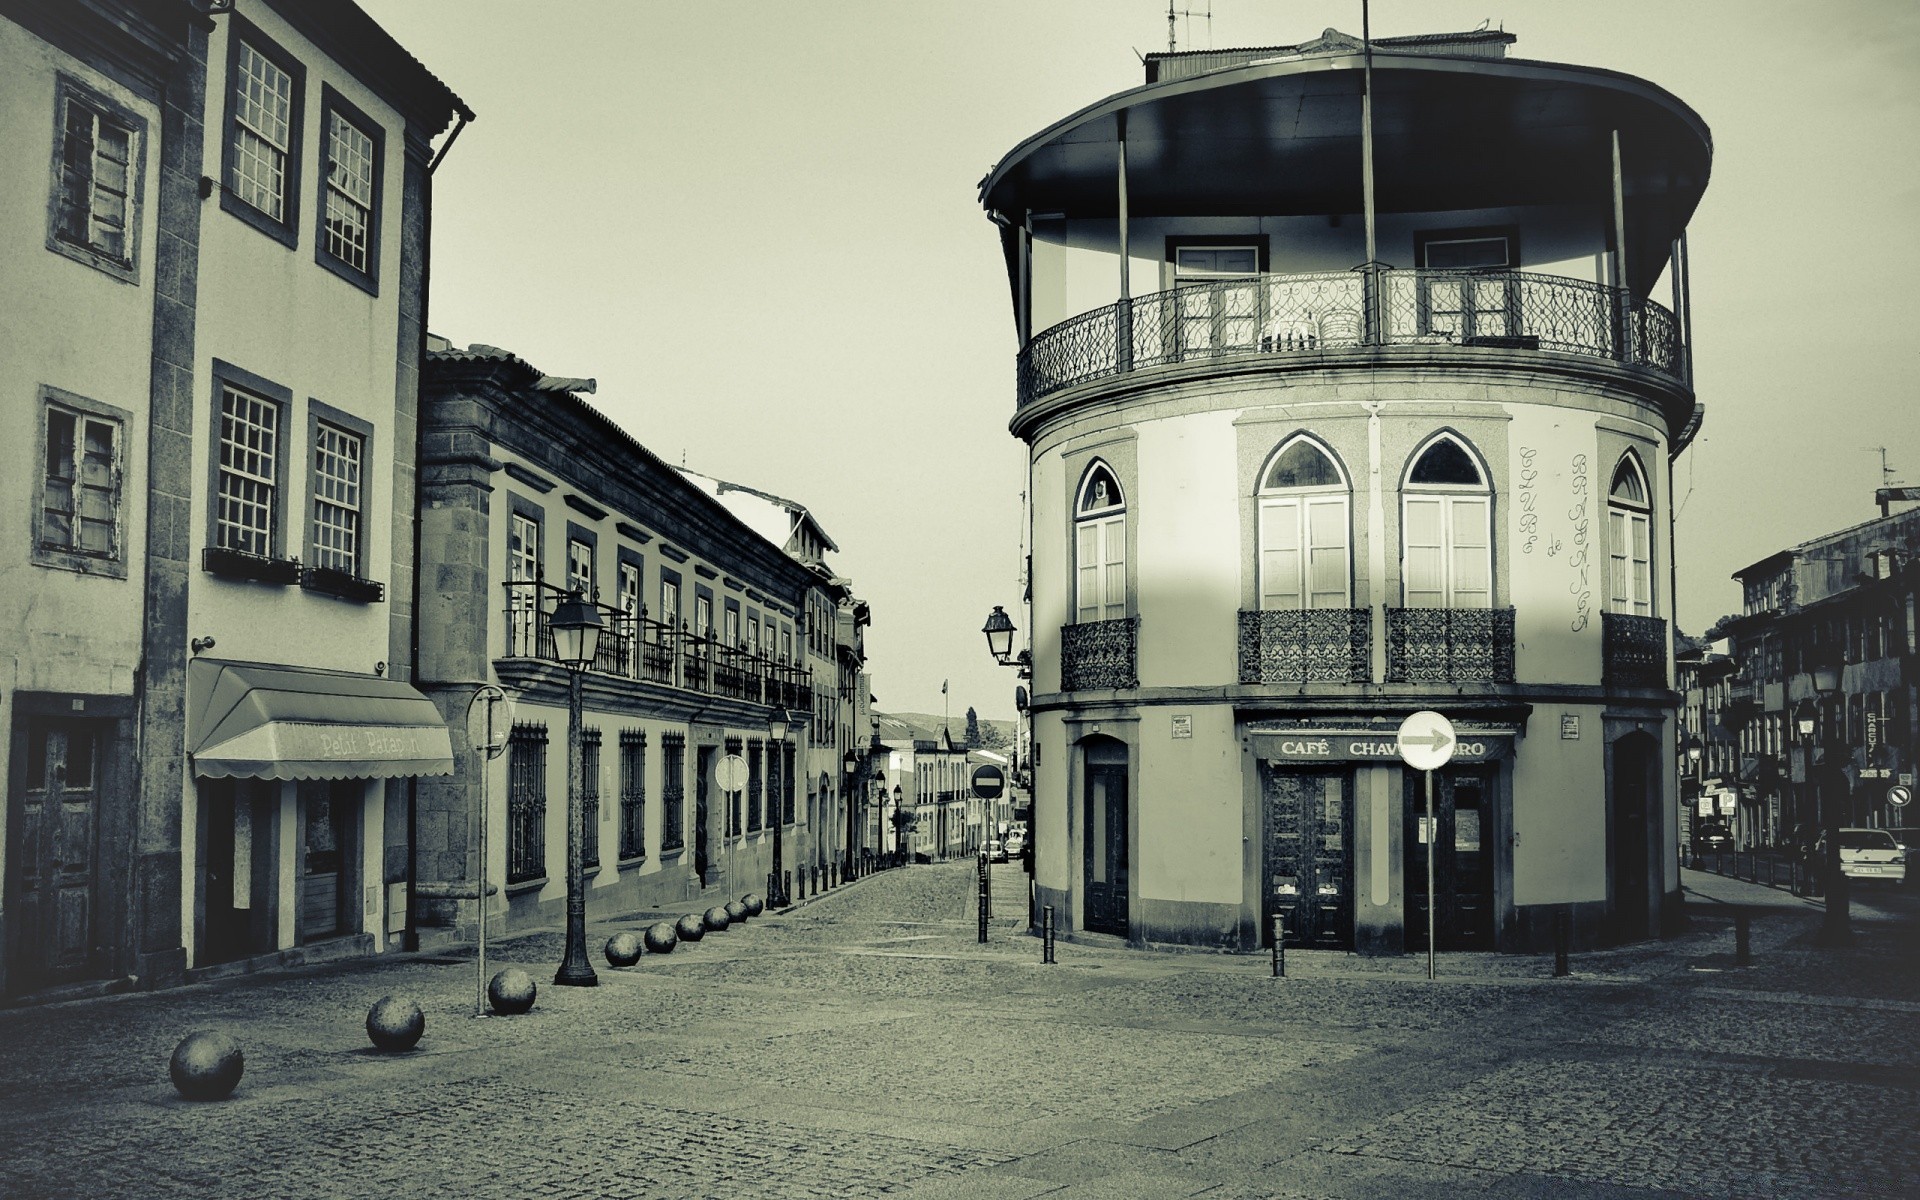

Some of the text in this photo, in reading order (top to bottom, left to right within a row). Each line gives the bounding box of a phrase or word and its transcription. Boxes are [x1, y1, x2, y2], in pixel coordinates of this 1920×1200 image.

[1518, 446, 1538, 554] CLUBE
[1547, 532, 1562, 558] de
[1567, 453, 1590, 633] BRAGANÇA
[320, 731, 421, 757] Petit Patapn
[1281, 738, 1330, 756] CAFÉ
